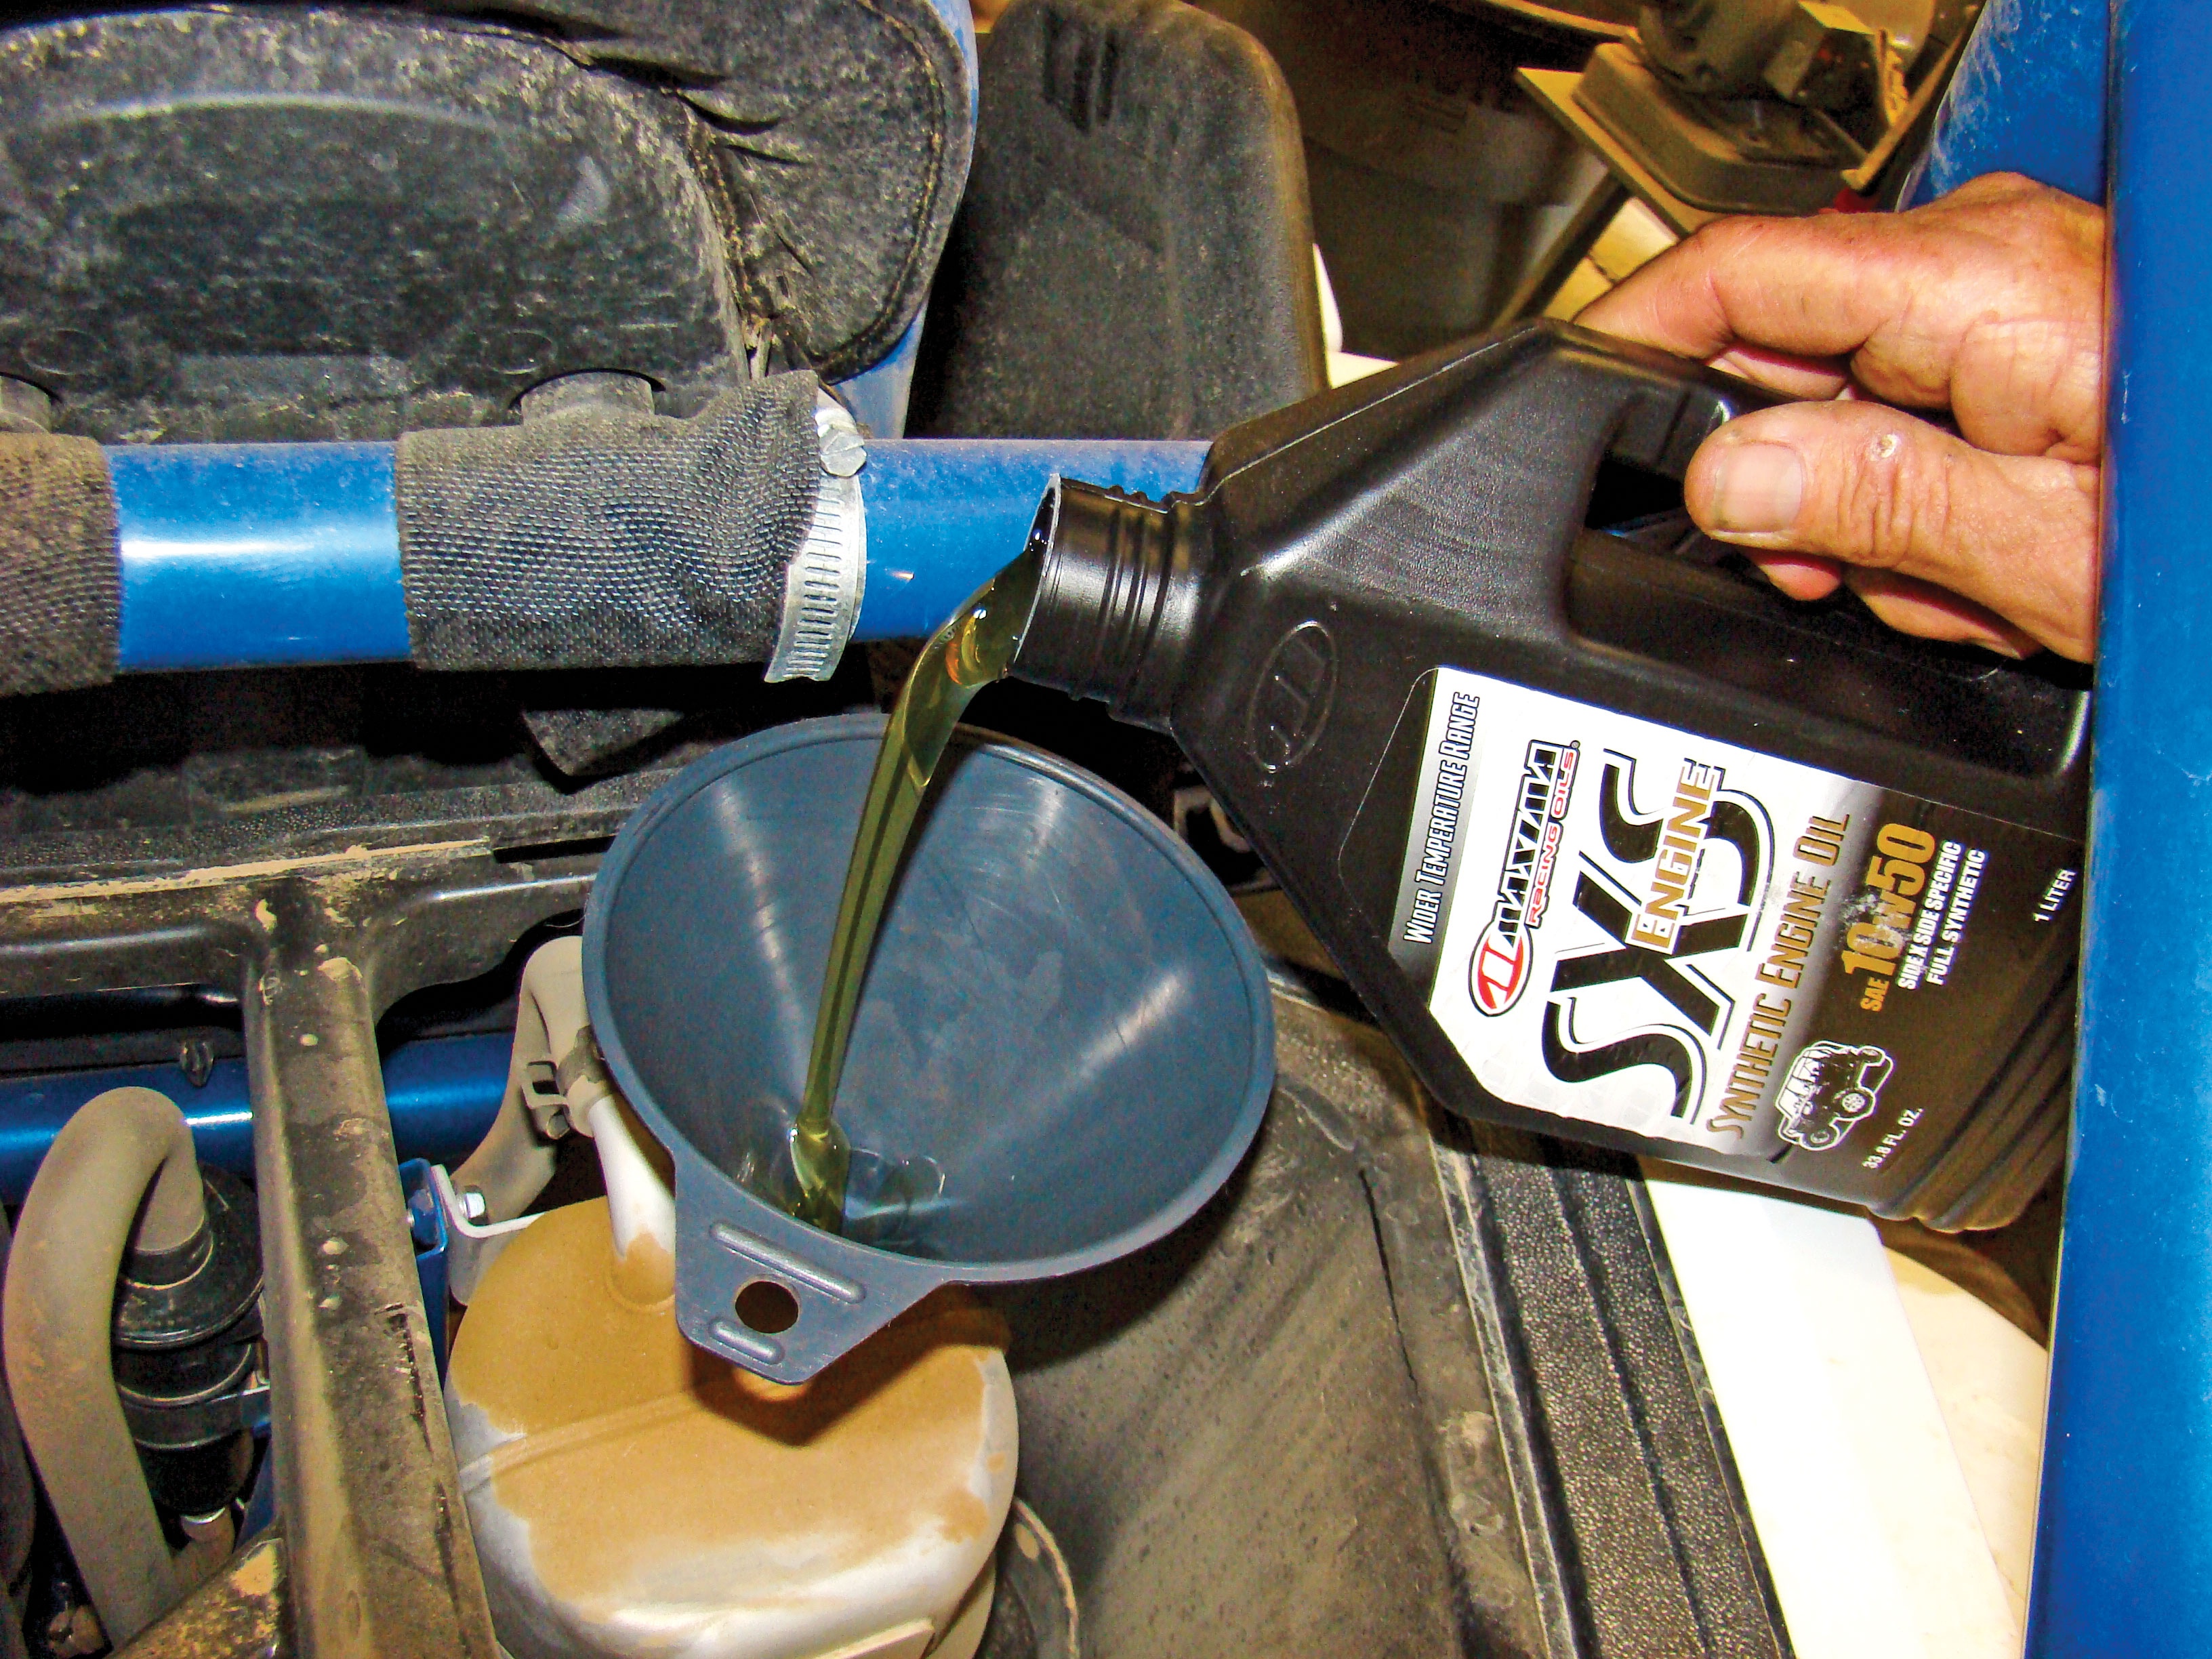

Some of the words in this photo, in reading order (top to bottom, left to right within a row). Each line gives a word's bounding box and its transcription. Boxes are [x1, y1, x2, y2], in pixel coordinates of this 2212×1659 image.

[1438, 691, 1480, 760] RANGE
[1552, 749, 1577, 817] OILS
[1415, 760, 1467, 886] TEMPERATURE
[1626, 758, 1725, 954] ENGINE
[1792, 813, 1850, 867] OIL
[1923, 839, 1962, 911] SPECIFIC
[2039, 868, 2076, 912] LITER
[1403, 888, 1442, 944] WIDER
[1754, 871, 1832, 989] ENGINE
[1911, 908, 1940, 946] SIDE
[1925, 943, 1955, 985] FULL
[1940, 848, 1986, 943] SYNTHETIC
[2033, 912, 2050, 922] 1
[1859, 977, 1890, 1012] SAE
[1896, 954, 1925, 991] SIDE
[1705, 992, 1793, 1140] SYNTHETIC
